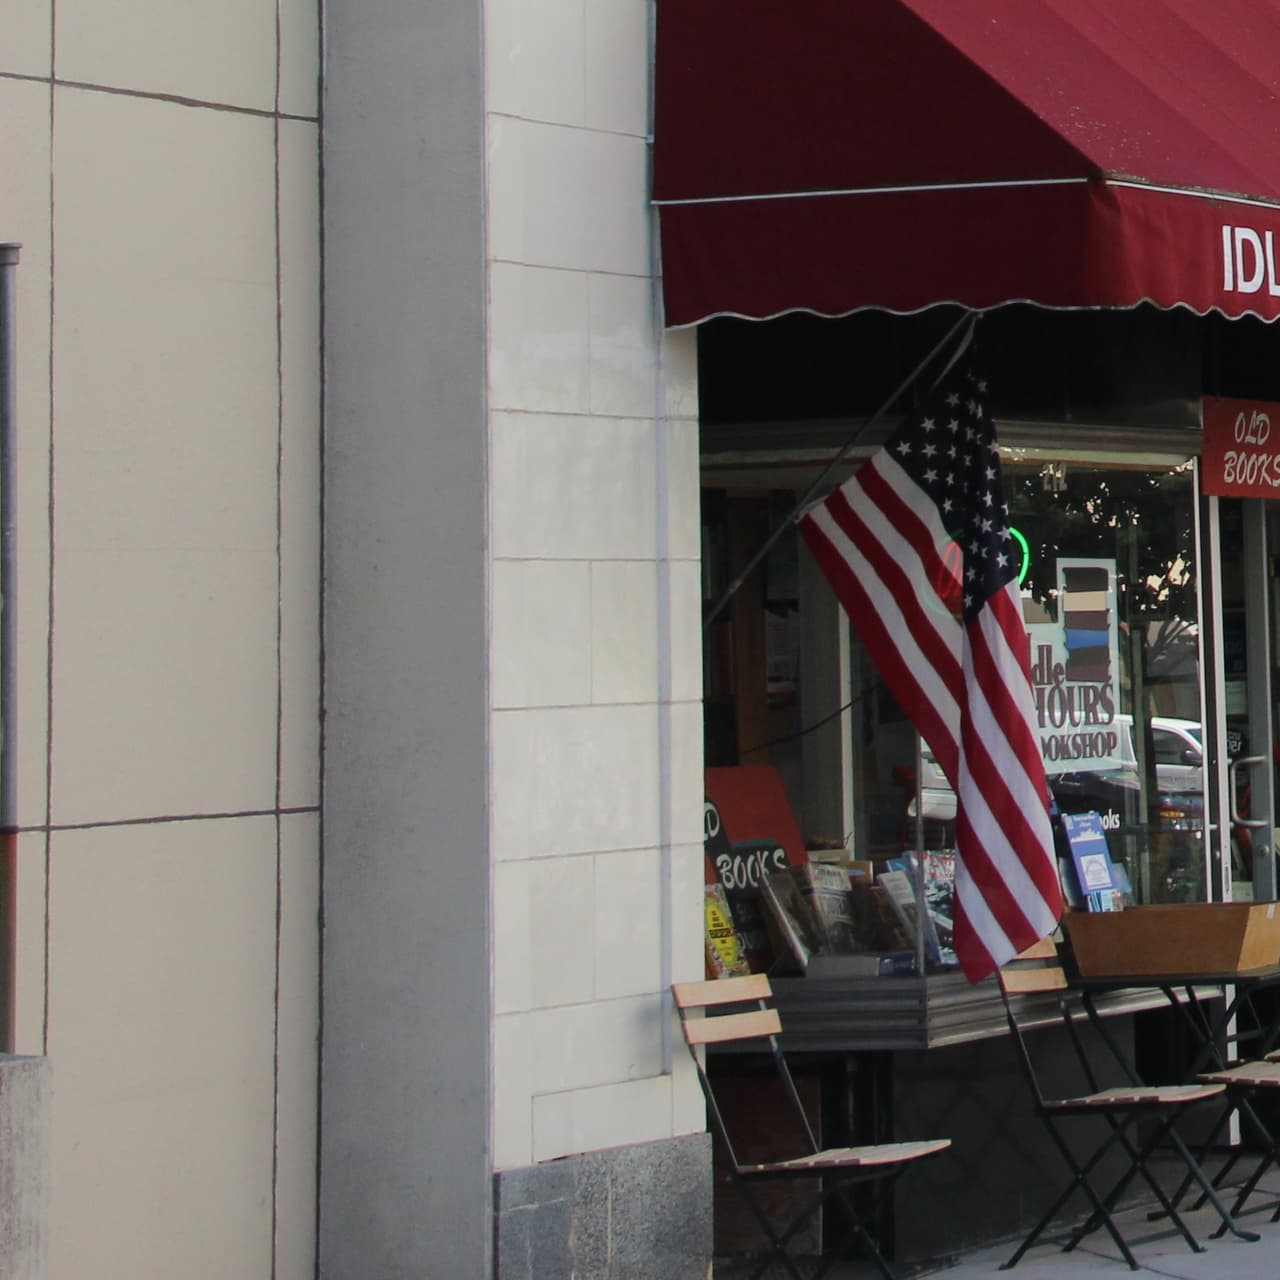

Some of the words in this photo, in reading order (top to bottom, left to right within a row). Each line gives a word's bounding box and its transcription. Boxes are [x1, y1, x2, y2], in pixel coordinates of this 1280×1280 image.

[1234, 410, 1271, 445] OLD
[1041, 732, 1118, 762] OKSHOP
[716, 848, 787, 890] BOOKS
